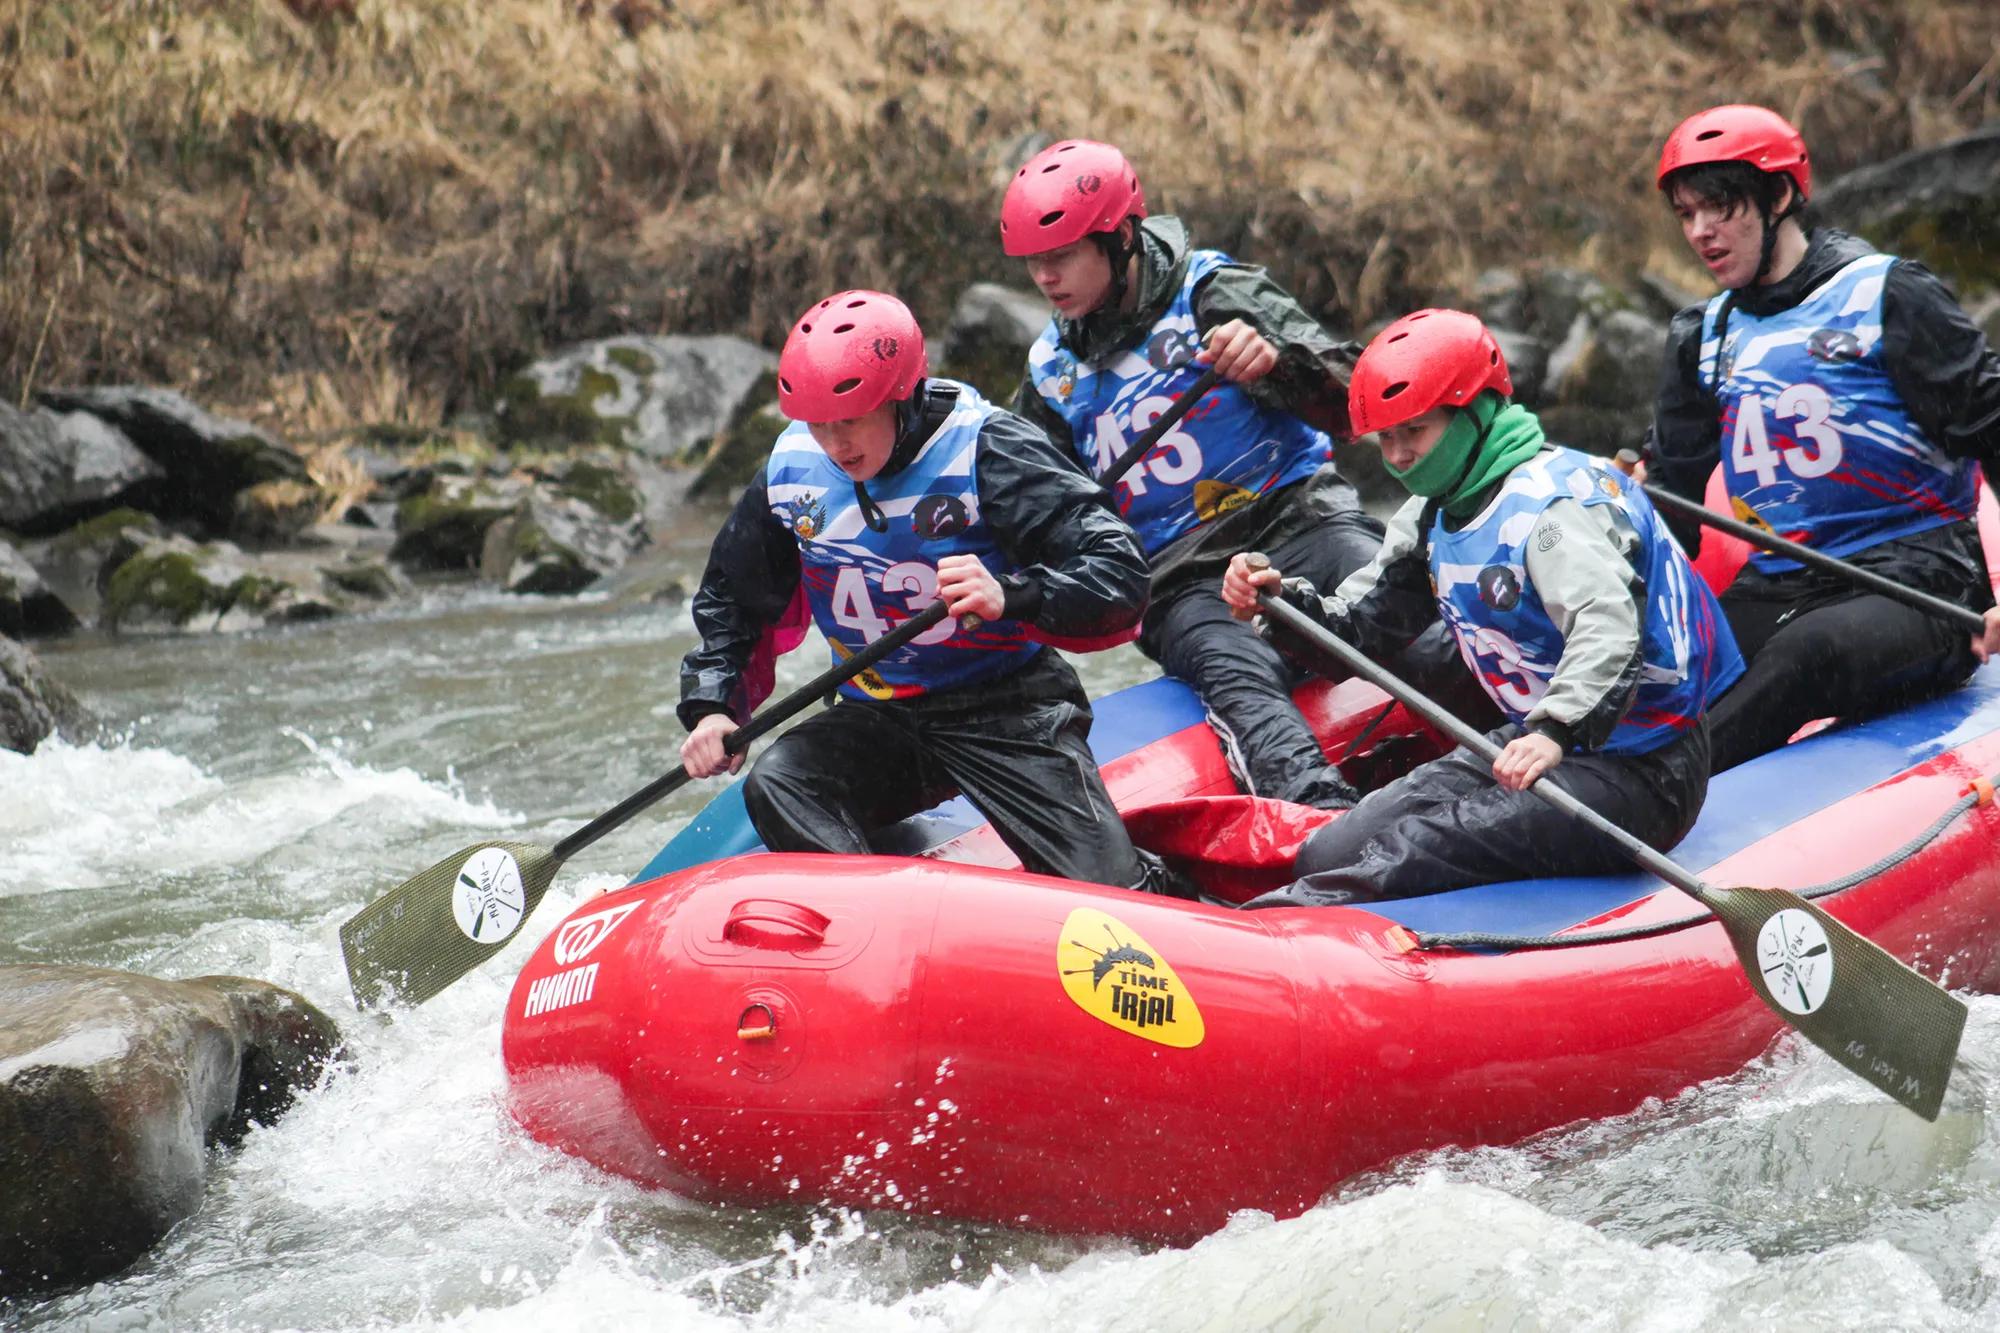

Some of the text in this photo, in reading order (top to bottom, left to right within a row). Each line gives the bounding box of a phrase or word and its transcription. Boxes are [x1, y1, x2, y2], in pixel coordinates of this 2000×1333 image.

[1093, 395, 1204, 497] 43
[1731, 383, 1843, 488] 43
[831, 561, 957, 646] 43
[523, 961, 600, 1018] НИИПП
